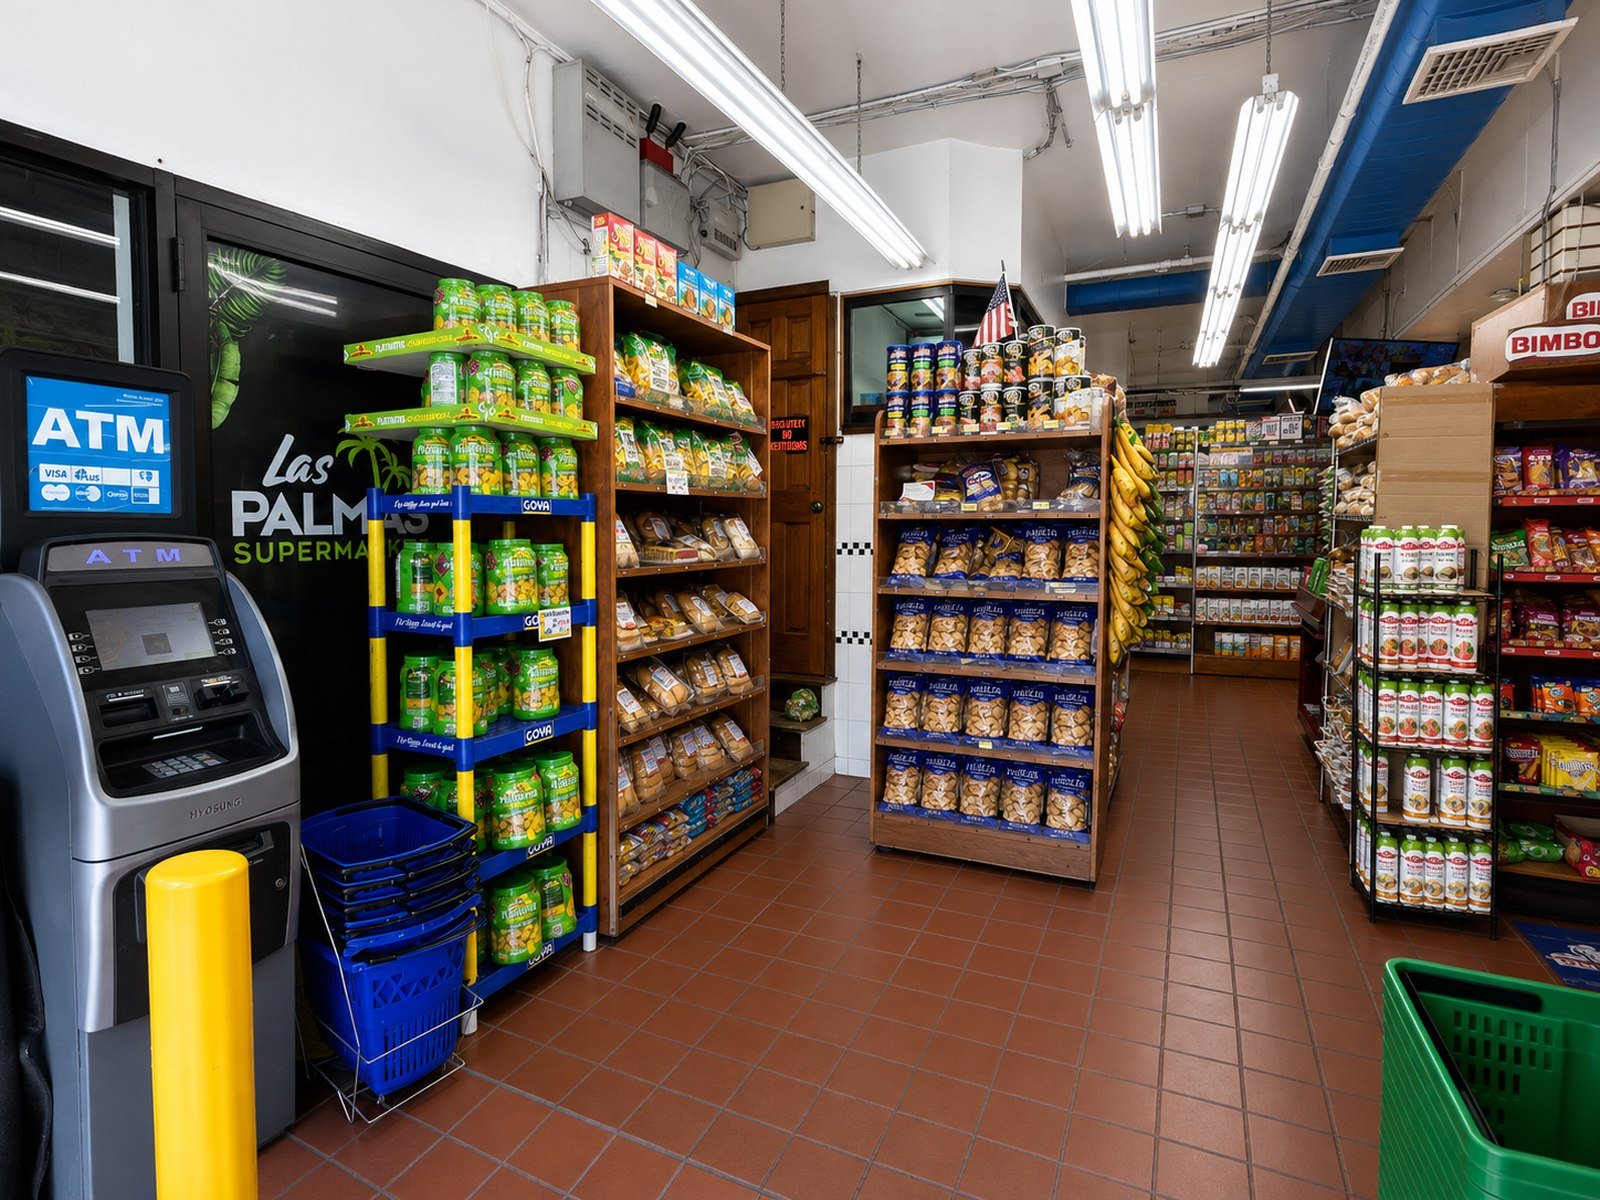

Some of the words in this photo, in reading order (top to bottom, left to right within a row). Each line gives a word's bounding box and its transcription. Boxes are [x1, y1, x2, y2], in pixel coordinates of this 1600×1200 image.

[1572, 300, 1600, 318] BI
[1511, 331, 1600, 354] BIMBO
[31, 407, 164, 454] ATM
[262, 433, 334, 487] Las
[45, 469, 67, 479] VISA
[80, 472, 100, 482] PLUS
[523, 500, 550, 511] GOYA
[86, 548, 181, 564] ATM
[234, 538, 428, 565] SUPERMAK
[525, 616, 539, 627] GO
[526, 724, 552, 741] GOYA
[190, 798, 242, 820] HYOSUNG
[528, 943, 553, 965] YA
